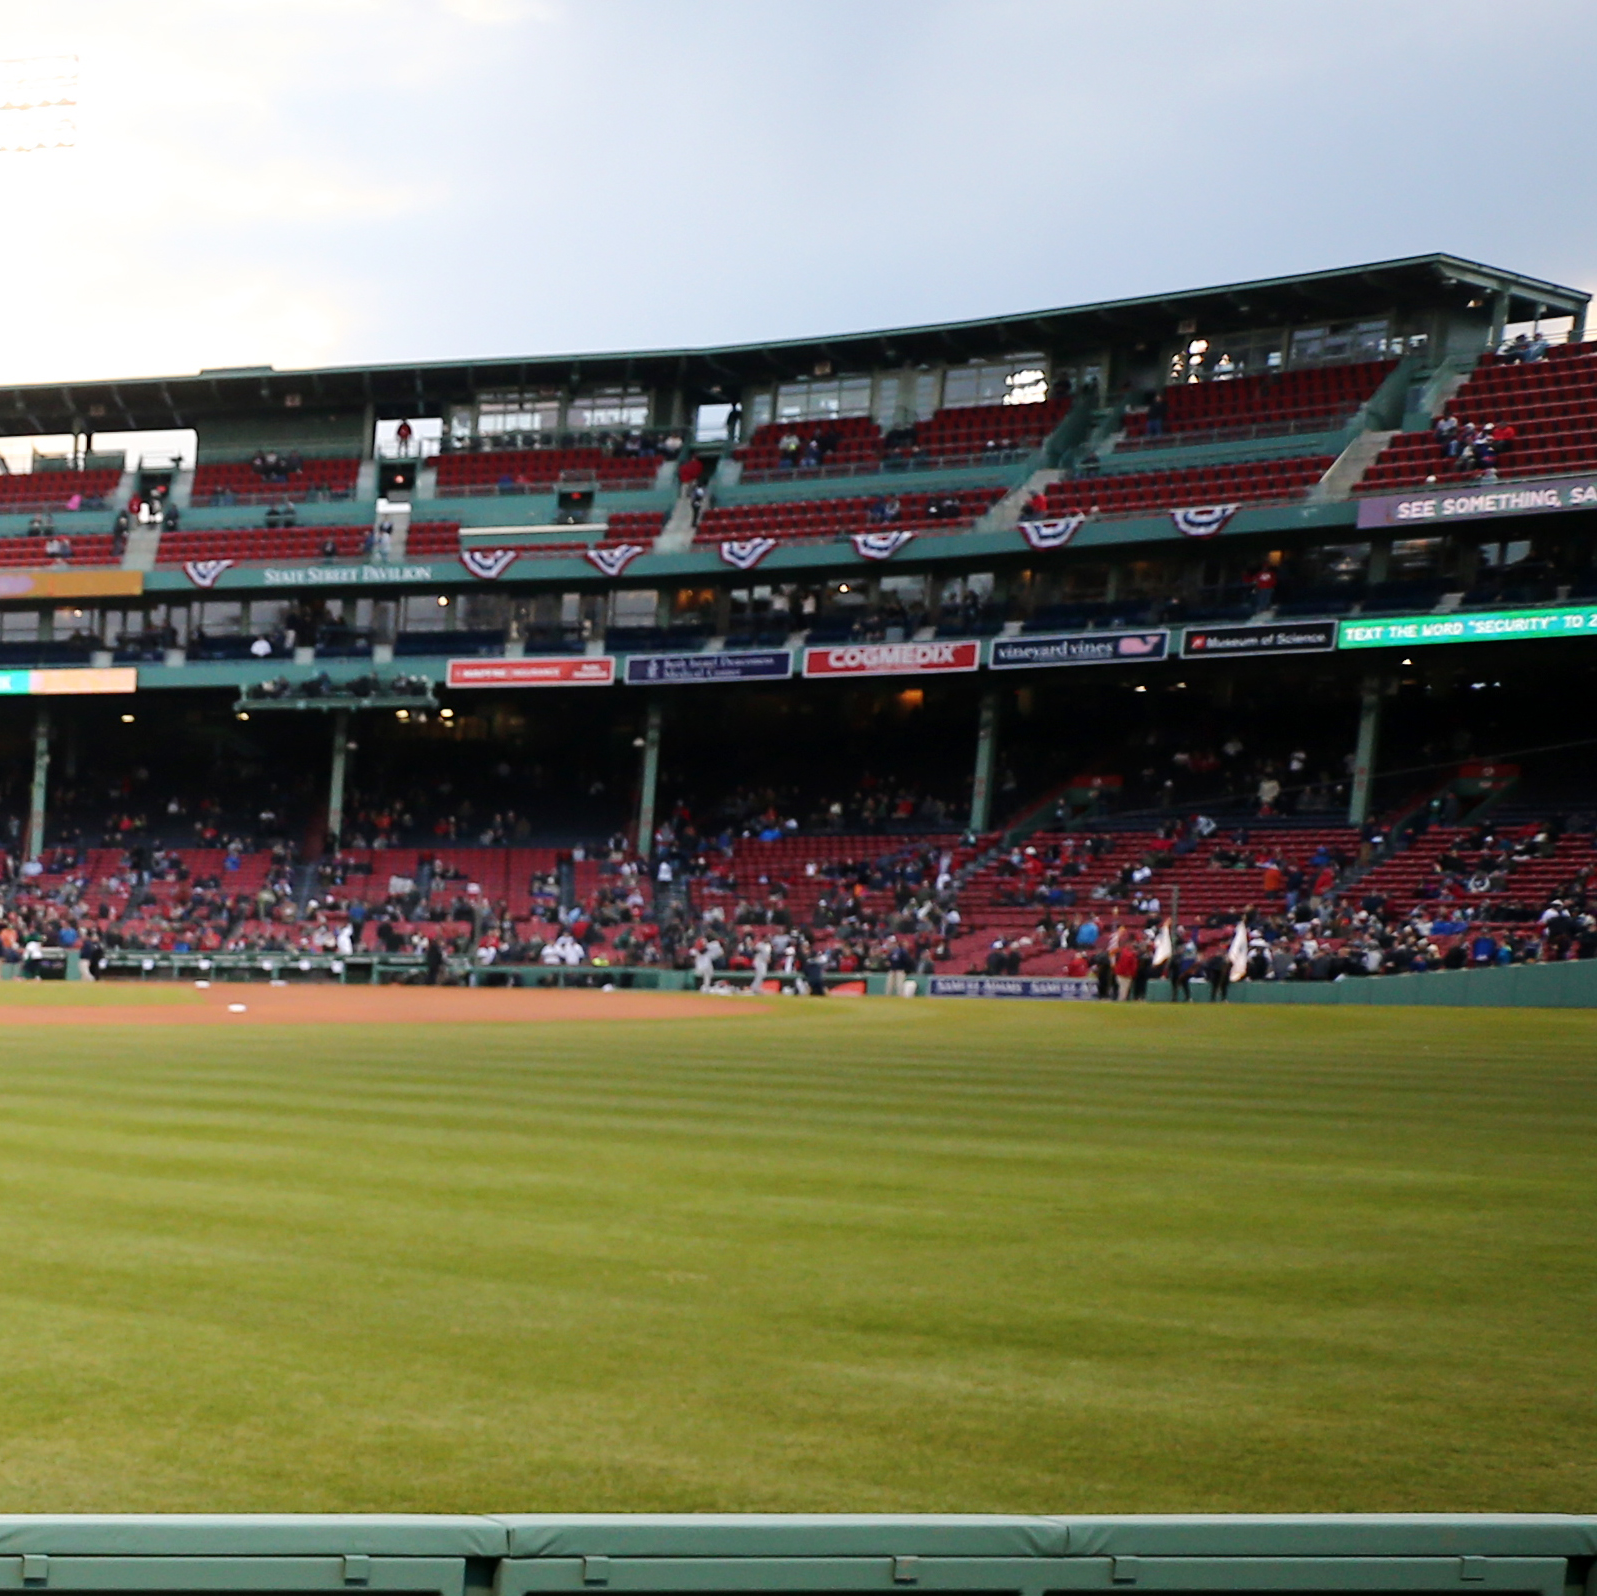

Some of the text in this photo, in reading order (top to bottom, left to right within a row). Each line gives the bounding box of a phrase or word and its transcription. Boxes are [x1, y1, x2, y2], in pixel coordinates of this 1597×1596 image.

[1397, 500, 1437, 519] SEE
[1441, 489, 1562, 516] SOMETHING,
[263, 564, 432, 585] STATE STREET PAVILION
[1345, 627, 1385, 641] TEXT
[1389, 625, 1418, 638] THE
[1422, 622, 1463, 637] WORD
[1563, 615, 1584, 628] TO
[997, 640, 1114, 662] vineyard vines
[1207, 632, 1326, 648] Museum of Science
[828, 645, 955, 668] COGMEDIX
